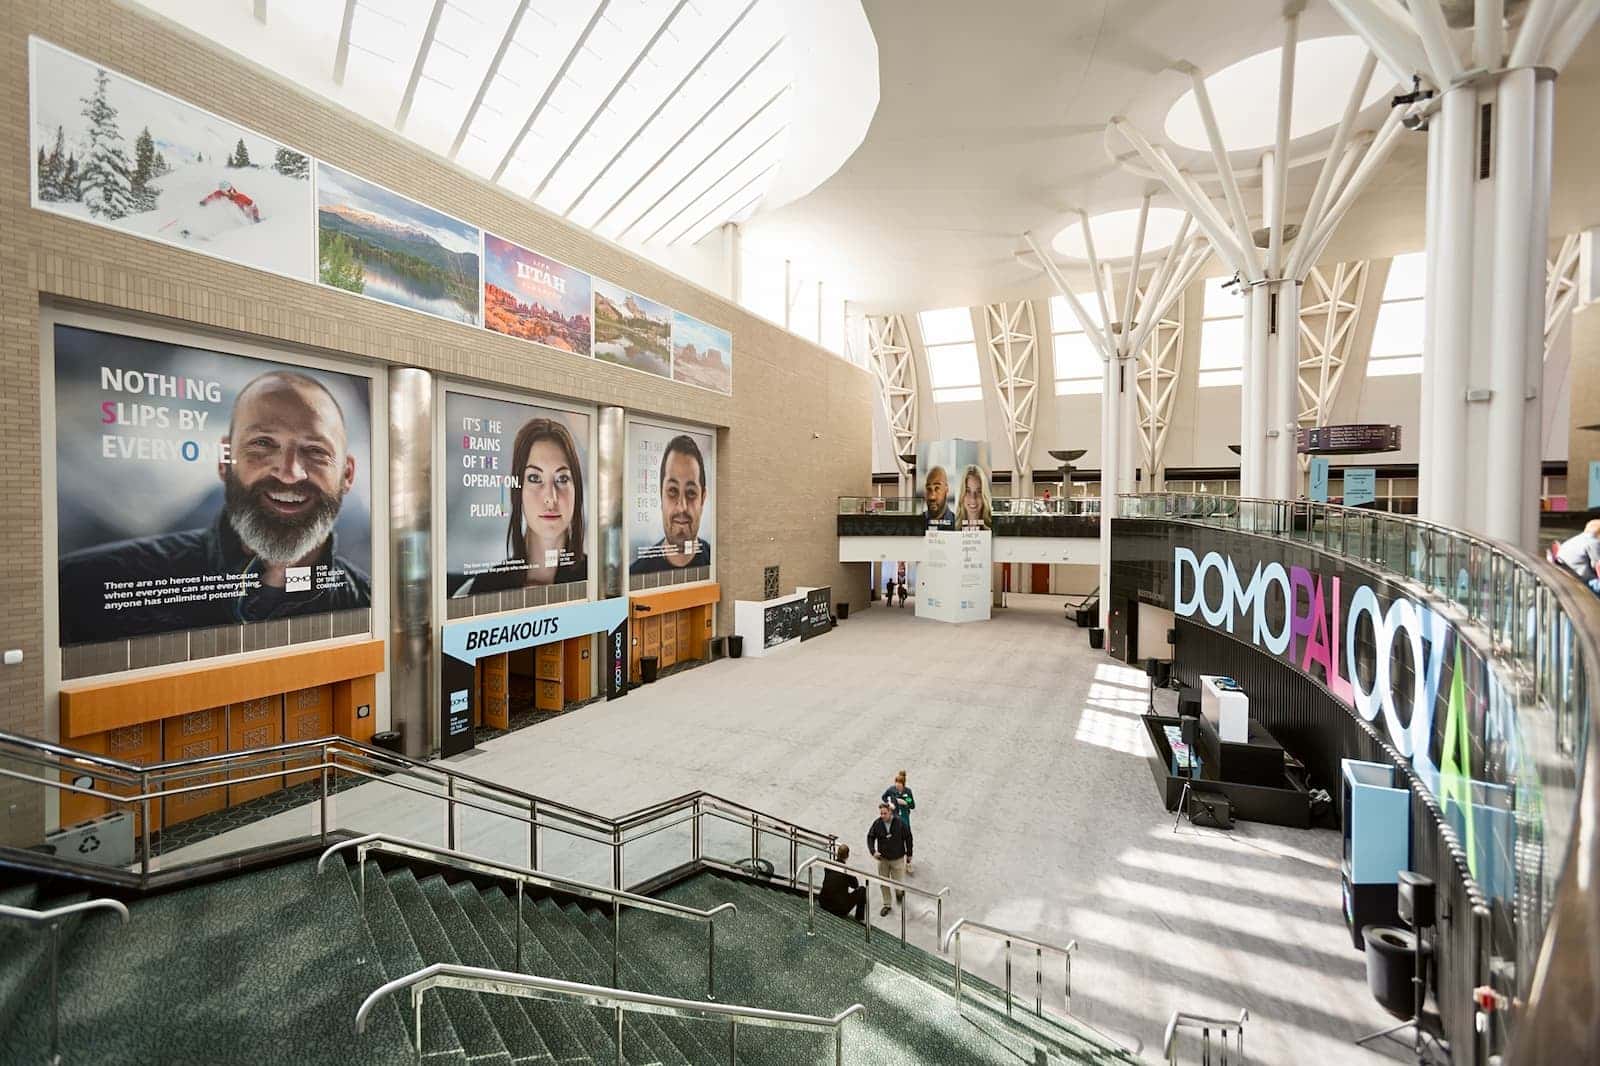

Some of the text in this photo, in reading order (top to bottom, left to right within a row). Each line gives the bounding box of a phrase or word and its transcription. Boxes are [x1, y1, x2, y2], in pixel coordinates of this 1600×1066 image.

[101, 366, 221, 403] NOTHING
[101, 401, 208, 431] SLIPS BY
[463, 417, 502, 434] IT'S THE
[463, 435, 501, 452] BRAINS
[463, 455, 498, 470] OF THE
[104, 571, 259, 590] There are no heroes here, because
[104, 590, 134, 600] when
[136, 587, 180, 597] everyone
[182, 585, 198, 593] can
[200, 584, 215, 592] see
[104, 599, 142, 610] anyone
[145, 597, 162, 606] has
[164, 592, 207, 604] unlimited
[466, 617, 559, 650] BREAKOUTS
[1174, 547, 1477, 880] DOMOPALOOZA
